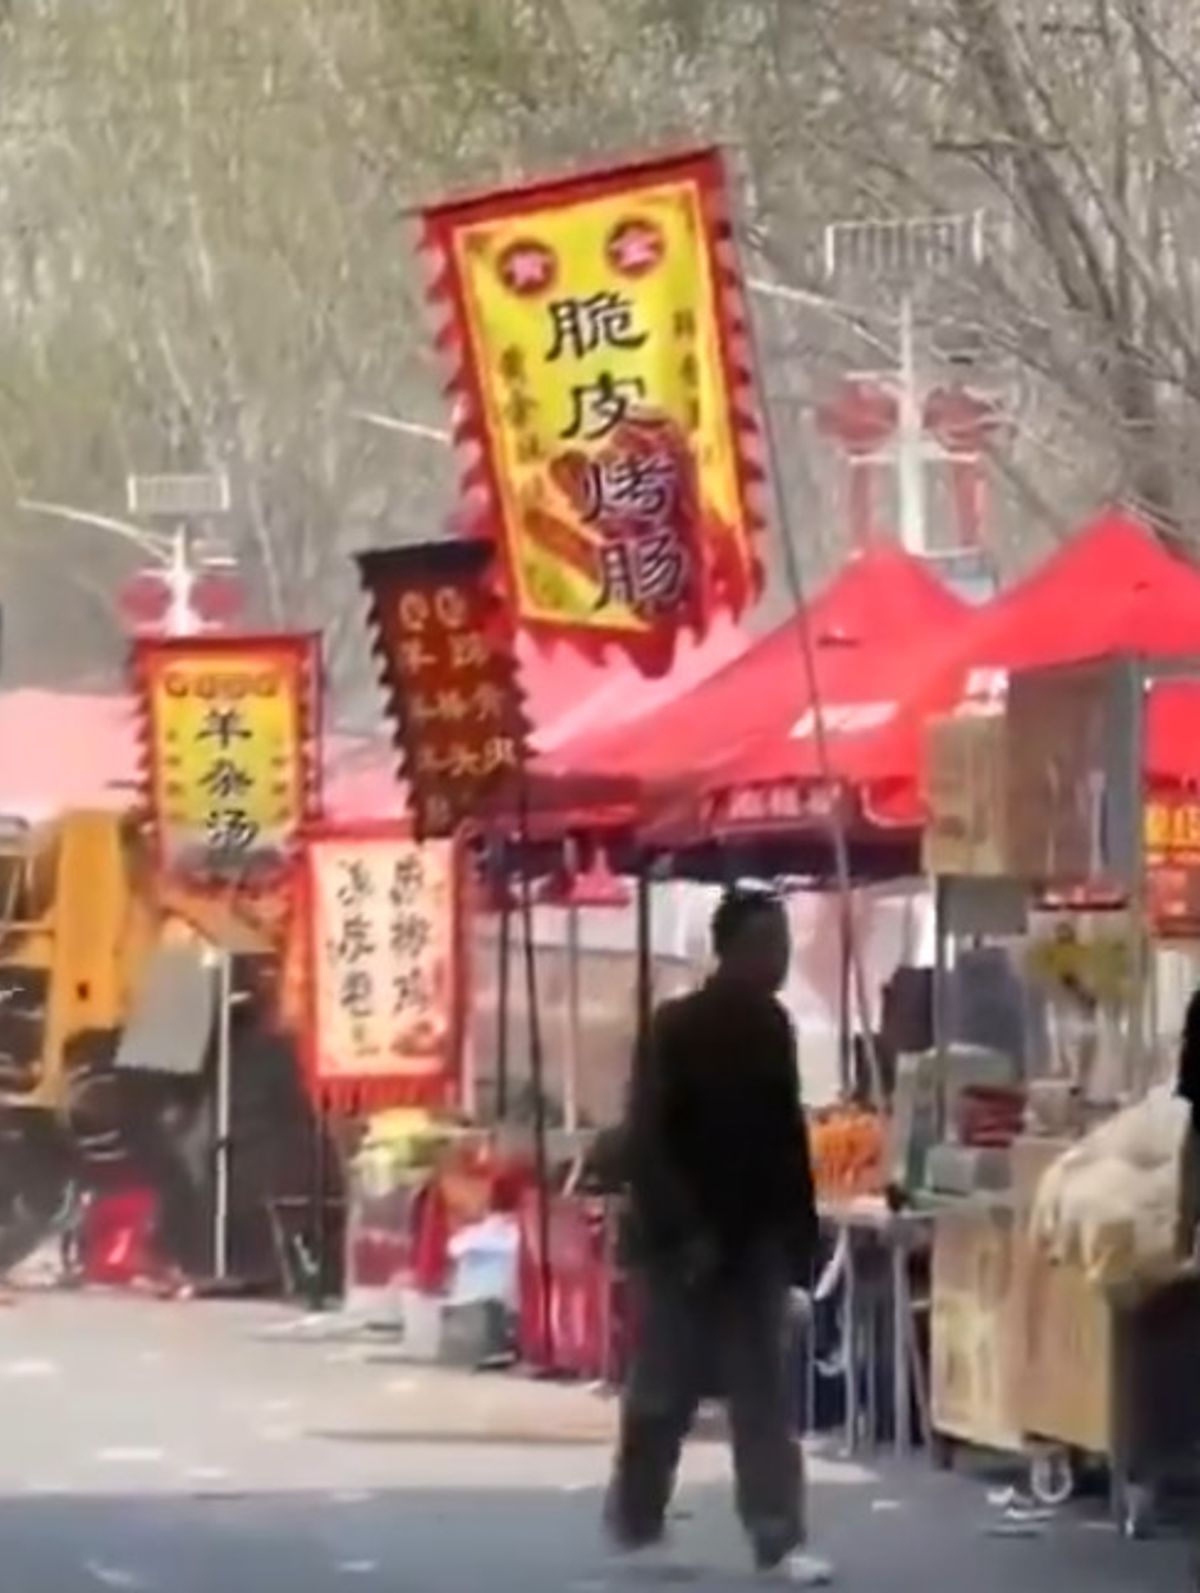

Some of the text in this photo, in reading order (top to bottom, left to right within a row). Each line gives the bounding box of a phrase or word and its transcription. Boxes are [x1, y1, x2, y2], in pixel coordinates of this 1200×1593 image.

[544, 289, 687, 616] 脆皮烤肠
[194, 707, 262, 850] 羊杂汤
